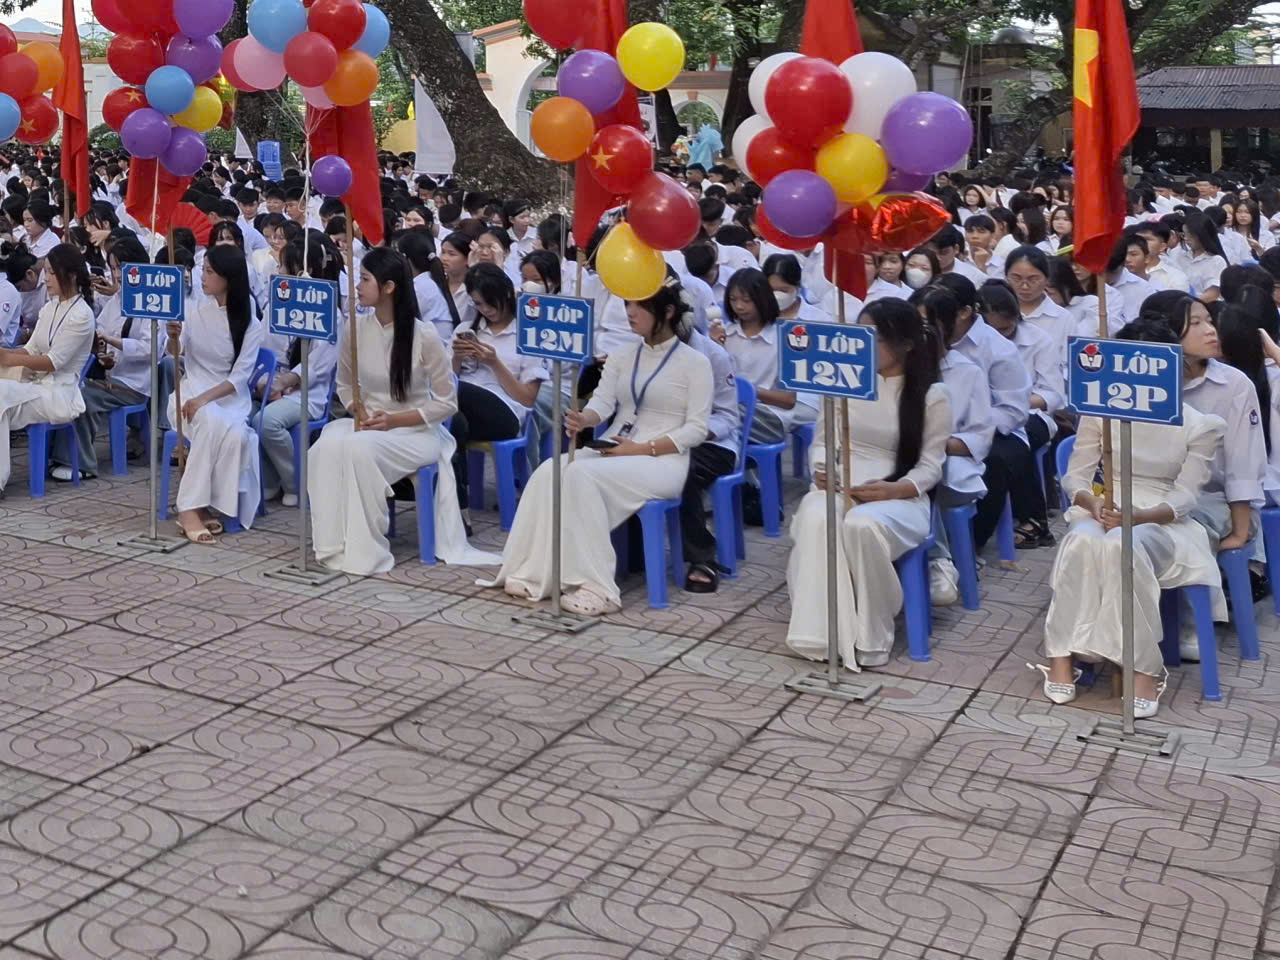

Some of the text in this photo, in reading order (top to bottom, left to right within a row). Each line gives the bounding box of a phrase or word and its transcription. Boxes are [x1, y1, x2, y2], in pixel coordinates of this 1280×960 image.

[145, 270, 176, 288] LỚP
[132, 292, 173, 313] 12I
[296, 285, 328, 305] LỚP
[274, 307, 328, 333] 12K
[546, 303, 585, 324] LỚP
[522, 327, 585, 355] 12M
[816, 331, 865, 355] LỚP
[790, 358, 865, 389] 12N
[1112, 350, 1168, 376] LỚP
[1081, 380, 1168, 412] 12P
